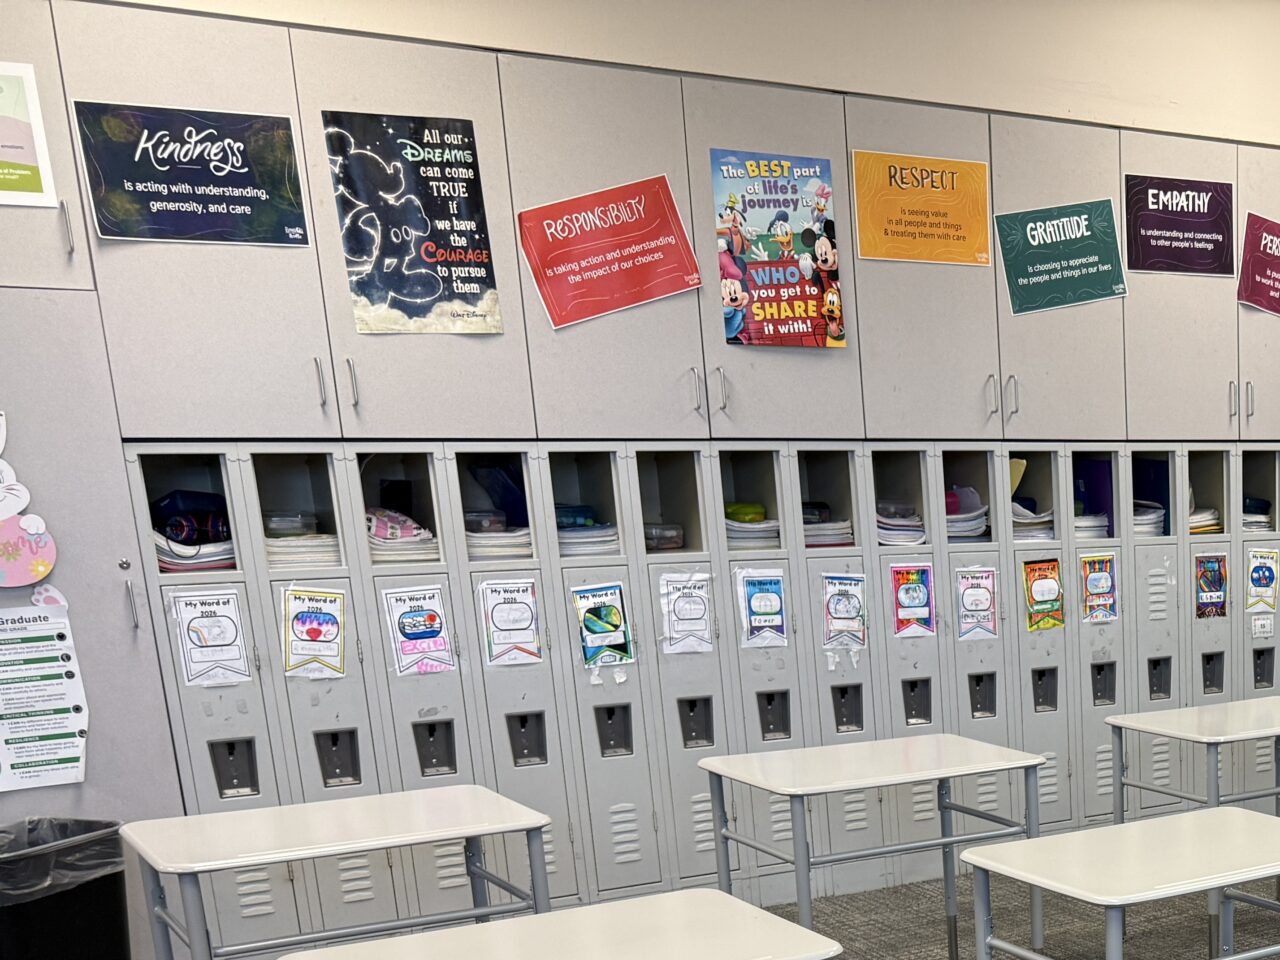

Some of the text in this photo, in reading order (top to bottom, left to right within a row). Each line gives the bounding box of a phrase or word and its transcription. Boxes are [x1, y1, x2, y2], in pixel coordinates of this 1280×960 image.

[424, 129, 462, 144] All our
[135, 127, 248, 176] Kindness
[420, 167, 474, 178] can come
[720, 160, 820, 178] The BEST part
[888, 165, 958, 190] RESPECT
[124, 180, 269, 199] is acting with understanding,
[430, 182, 468, 197] TRUE
[746, 180, 798, 195] of life's
[150, 201, 251, 214] generosity, and care
[449, 201, 457, 213] if
[741, 195, 812, 213] journey is
[1148, 189, 1212, 213] EMPATHY
[908, 209, 929, 218] seeing
[436, 217, 476, 230] we have
[905, 220, 927, 229] people
[943, 222, 962, 231] things
[1027, 215, 1091, 246] GRATITUDE
[450, 233, 467, 246] the
[891, 229, 916, 239] treating
[918, 231, 935, 239] them
[936, 232, 951, 240] with
[1147, 229, 1183, 239] understanding
[1195, 233, 1222, 241] connecting
[421, 241, 489, 262] COURAGE
[1194, 242, 1214, 250] feelings
[546, 235, 675, 277] is taking action and understanding
[1034, 262, 1060, 272] choosing
[1069, 255, 1099, 266] appreciate
[437, 265, 486, 280] to pursue
[568, 252, 663, 283] the impact of our choices
[1267, 268, 1271, 276] is
[750, 267, 800, 286] WHO
[1018, 277, 1028, 285] the
[1030, 274, 1049, 284] people
[1051, 271, 1062, 279] and
[1062, 269, 1081, 278] things
[1261, 277, 1274, 287] work
[453, 280, 480, 293] them
[752, 285, 818, 300] you get to
[1270, 290, 1279, 298] and
[752, 300, 818, 321] SHARE
[764, 322, 812, 334] it with!
[0, 615, 49, 626] Graduate
